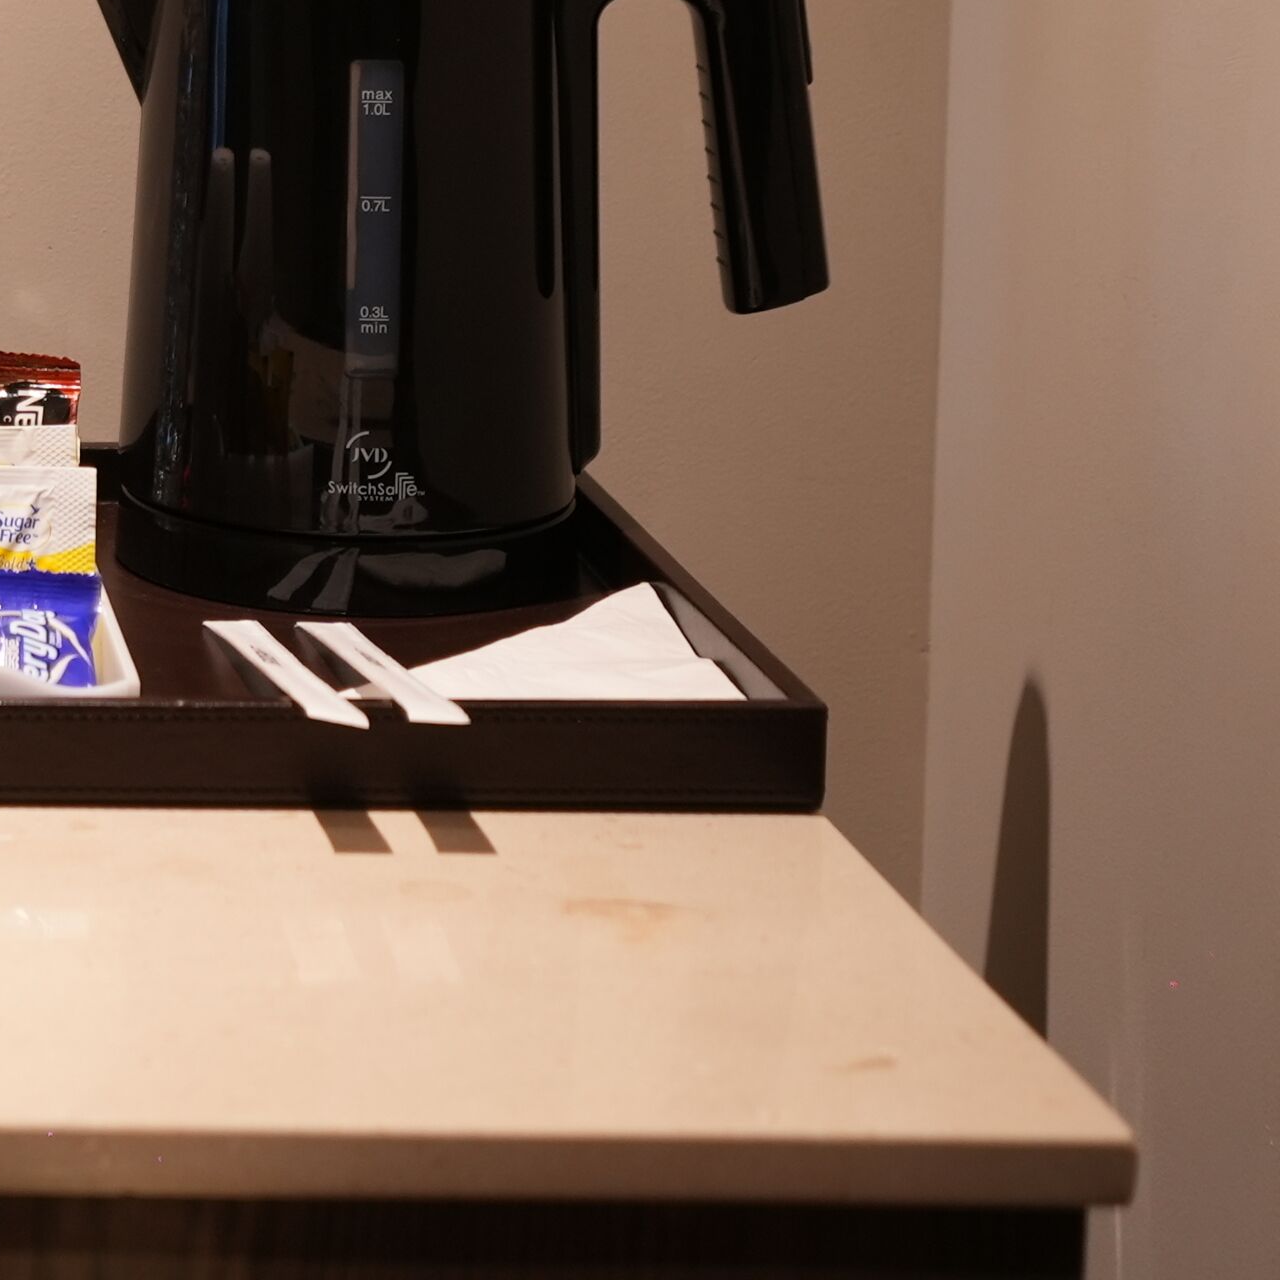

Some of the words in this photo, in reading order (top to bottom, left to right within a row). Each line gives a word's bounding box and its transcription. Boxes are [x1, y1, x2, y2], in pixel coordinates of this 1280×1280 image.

[361, 90, 393, 100] max
[363, 103, 391, 116] 1.0L
[361, 200, 390, 213] 0.7L
[360, 306, 389, 318] 0.3L
[360, 322, 387, 334] min
[351, 447, 388, 463] JVD
[0, 529, 32, 544] Free
